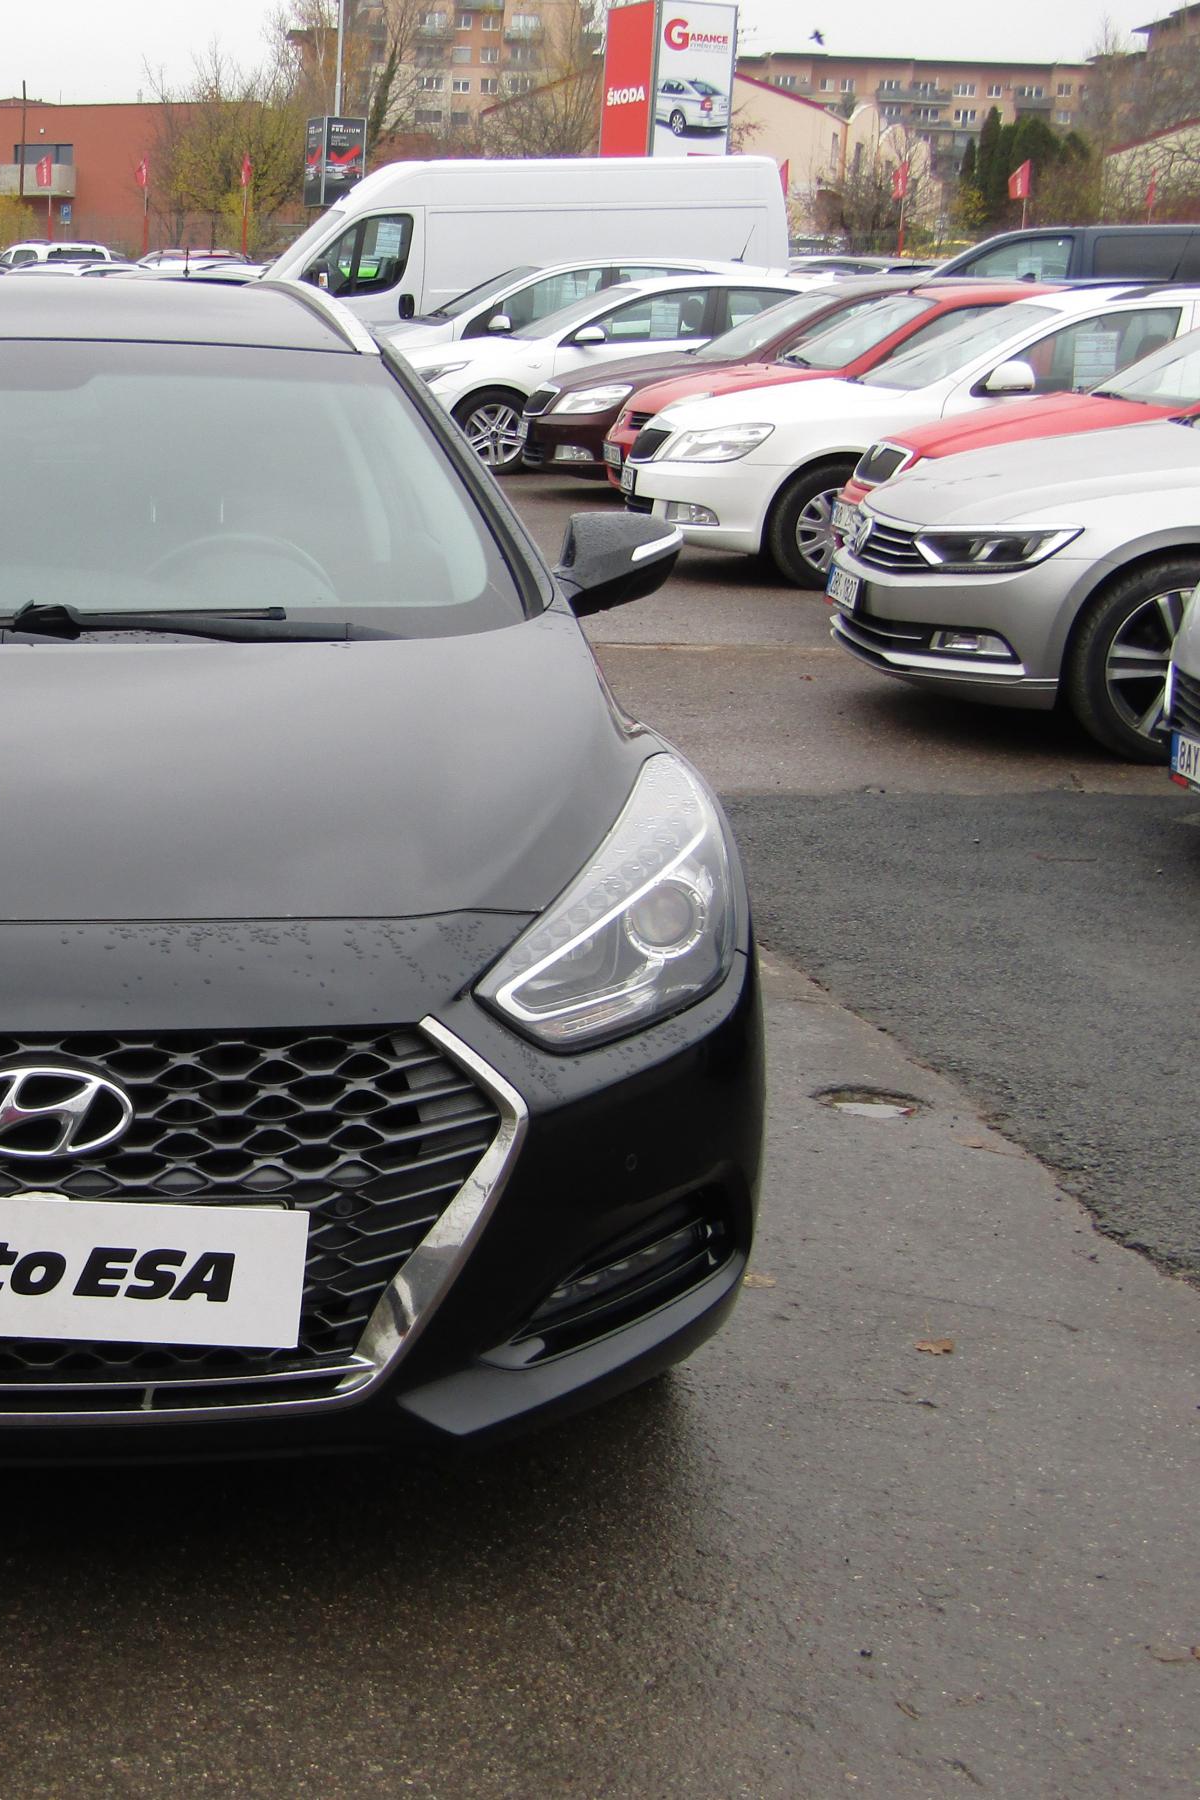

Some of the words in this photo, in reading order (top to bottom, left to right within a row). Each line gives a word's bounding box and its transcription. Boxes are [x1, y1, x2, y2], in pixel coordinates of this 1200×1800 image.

[664, 18, 729, 51] GARANCE
[606, 85, 646, 107] ŠKODA
[72, 1247, 236, 1303] ESA
